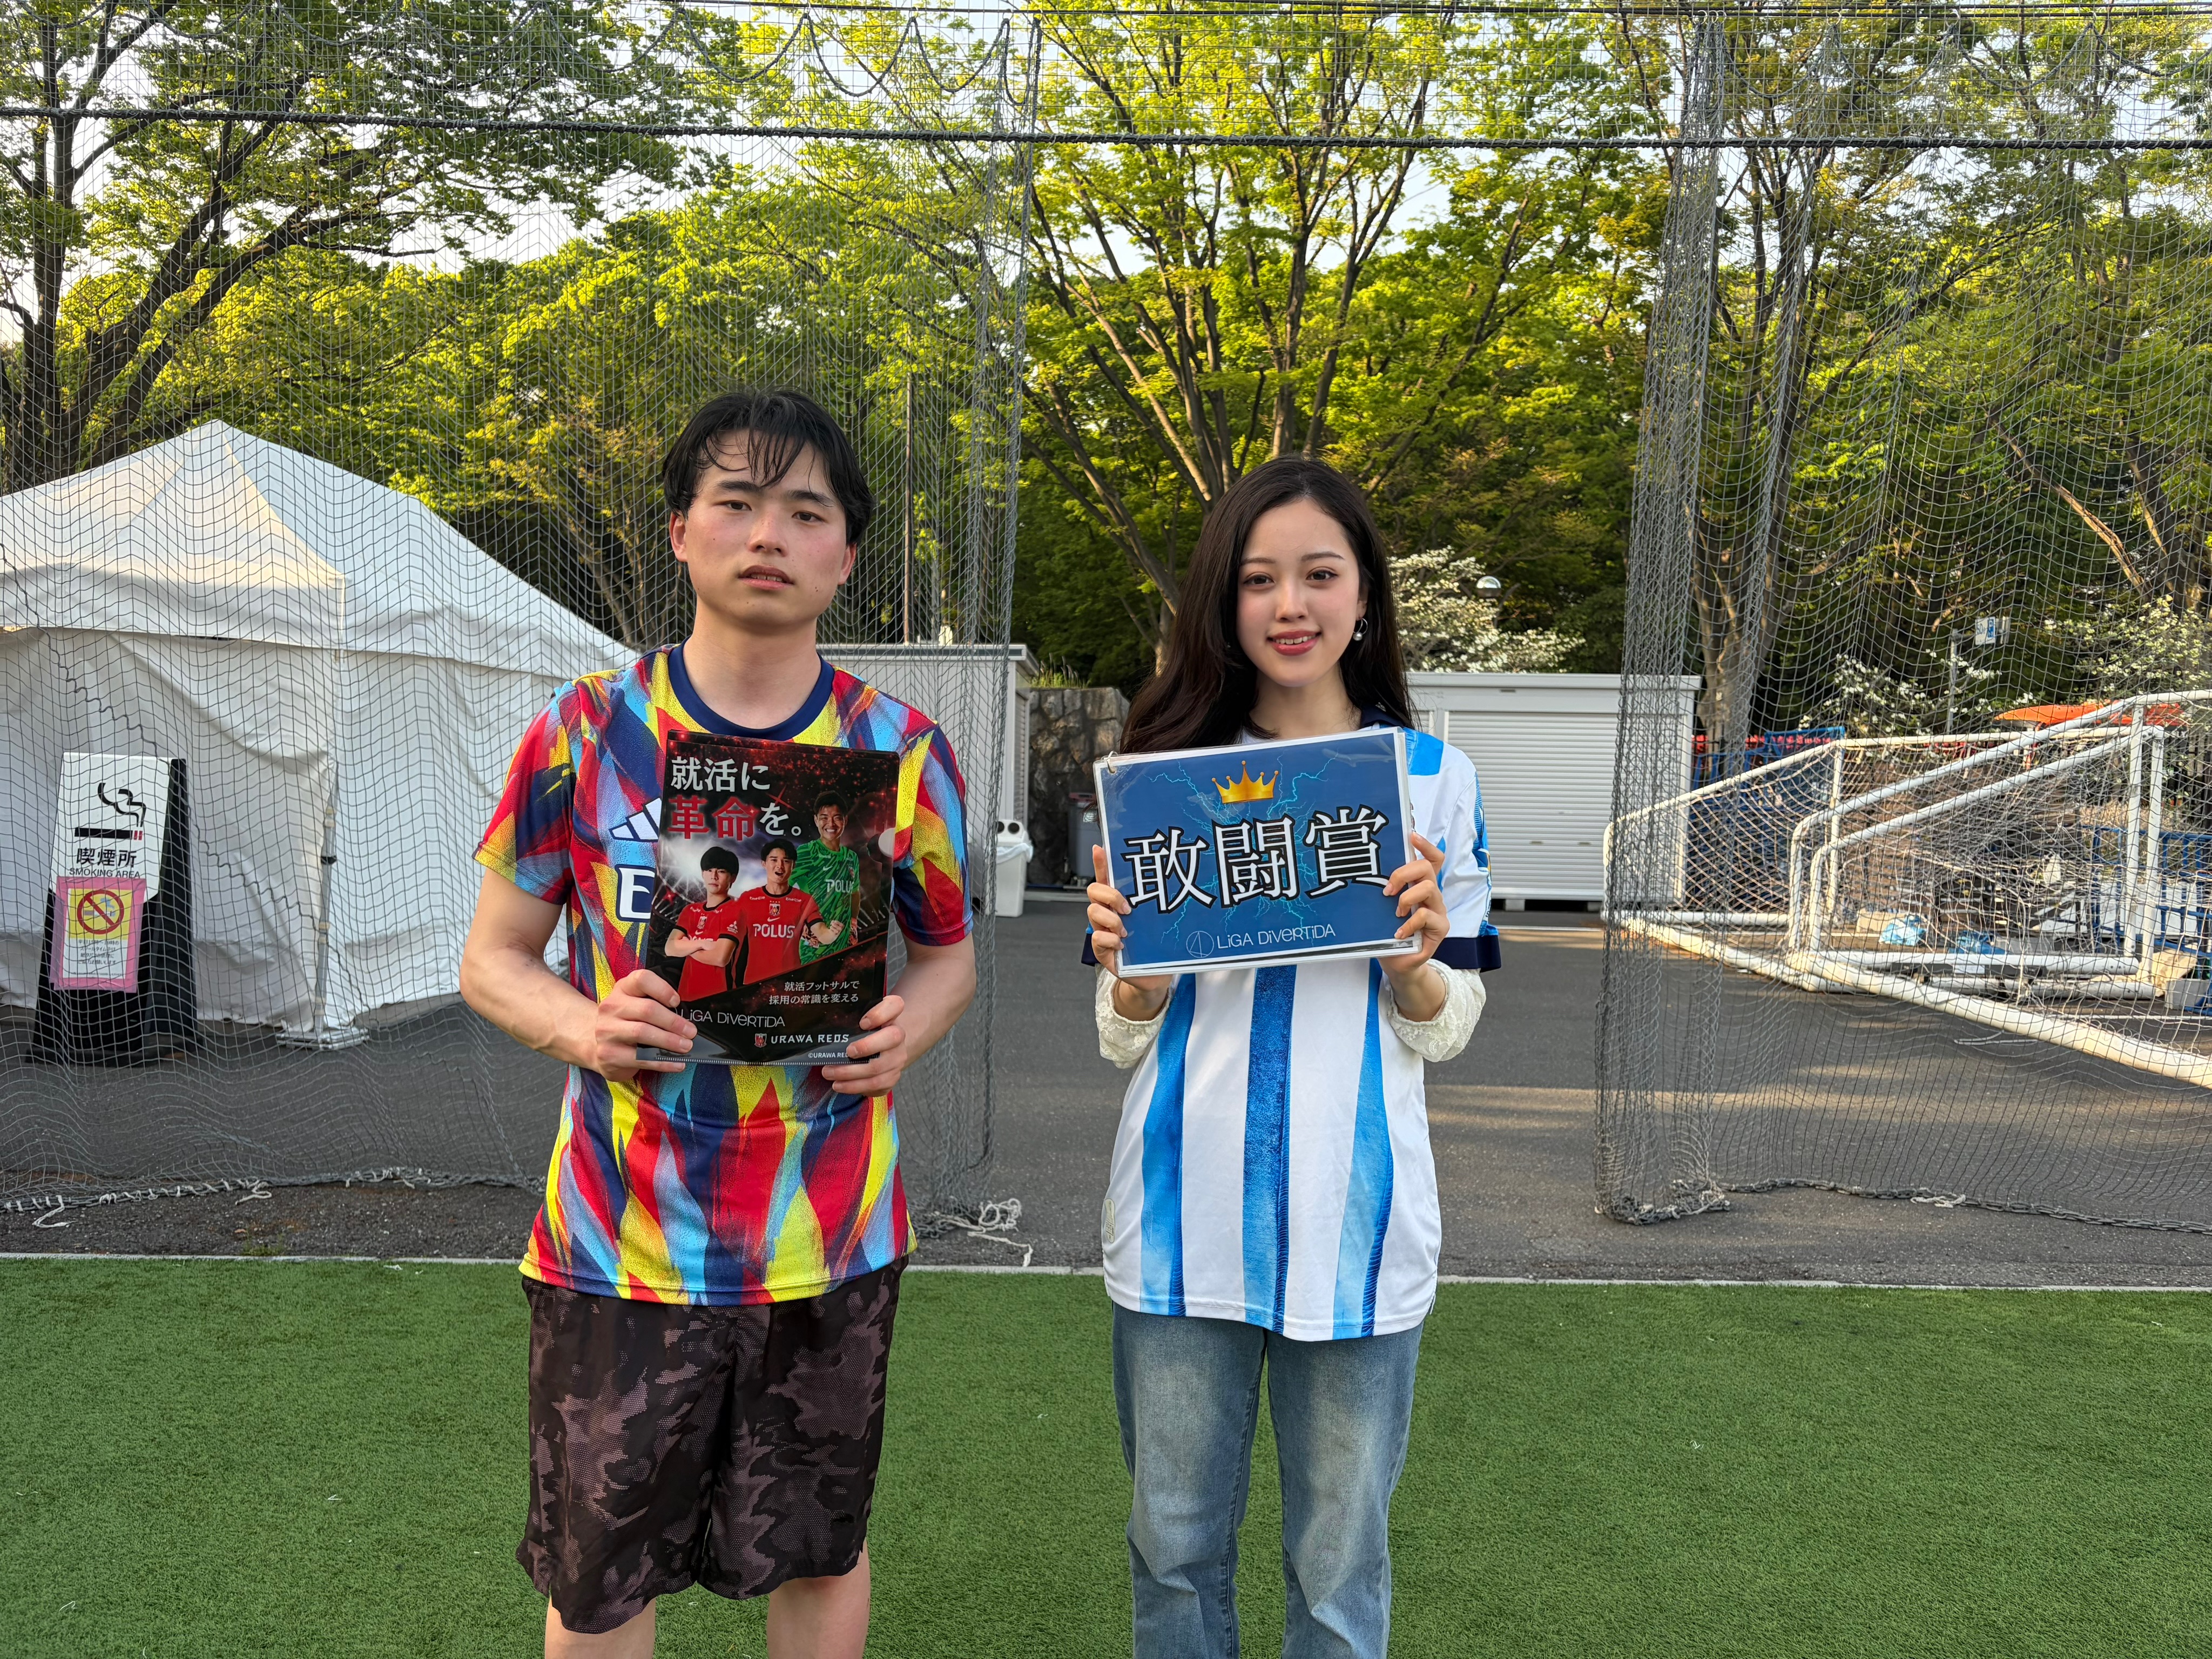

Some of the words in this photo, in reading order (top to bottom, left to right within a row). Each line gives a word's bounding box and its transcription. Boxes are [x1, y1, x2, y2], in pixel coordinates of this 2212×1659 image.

[671, 756, 770, 792] 就活に
[667, 794, 801, 841] 革命を。
[76, 848, 137, 868] 喫煙所
[1121, 805, 1389, 913] 敢闘賞
[69, 868, 113, 877] SMOKING
[116, 870, 140, 878] AREA
[753, 923, 795, 939] POLUS
[784, 981, 860, 992] 就活フットサルで
[768, 994, 859, 1006] 採用の常識を変える
[771, 1034, 813, 1044] URAWA
[818, 1034, 850, 1043] REDS
